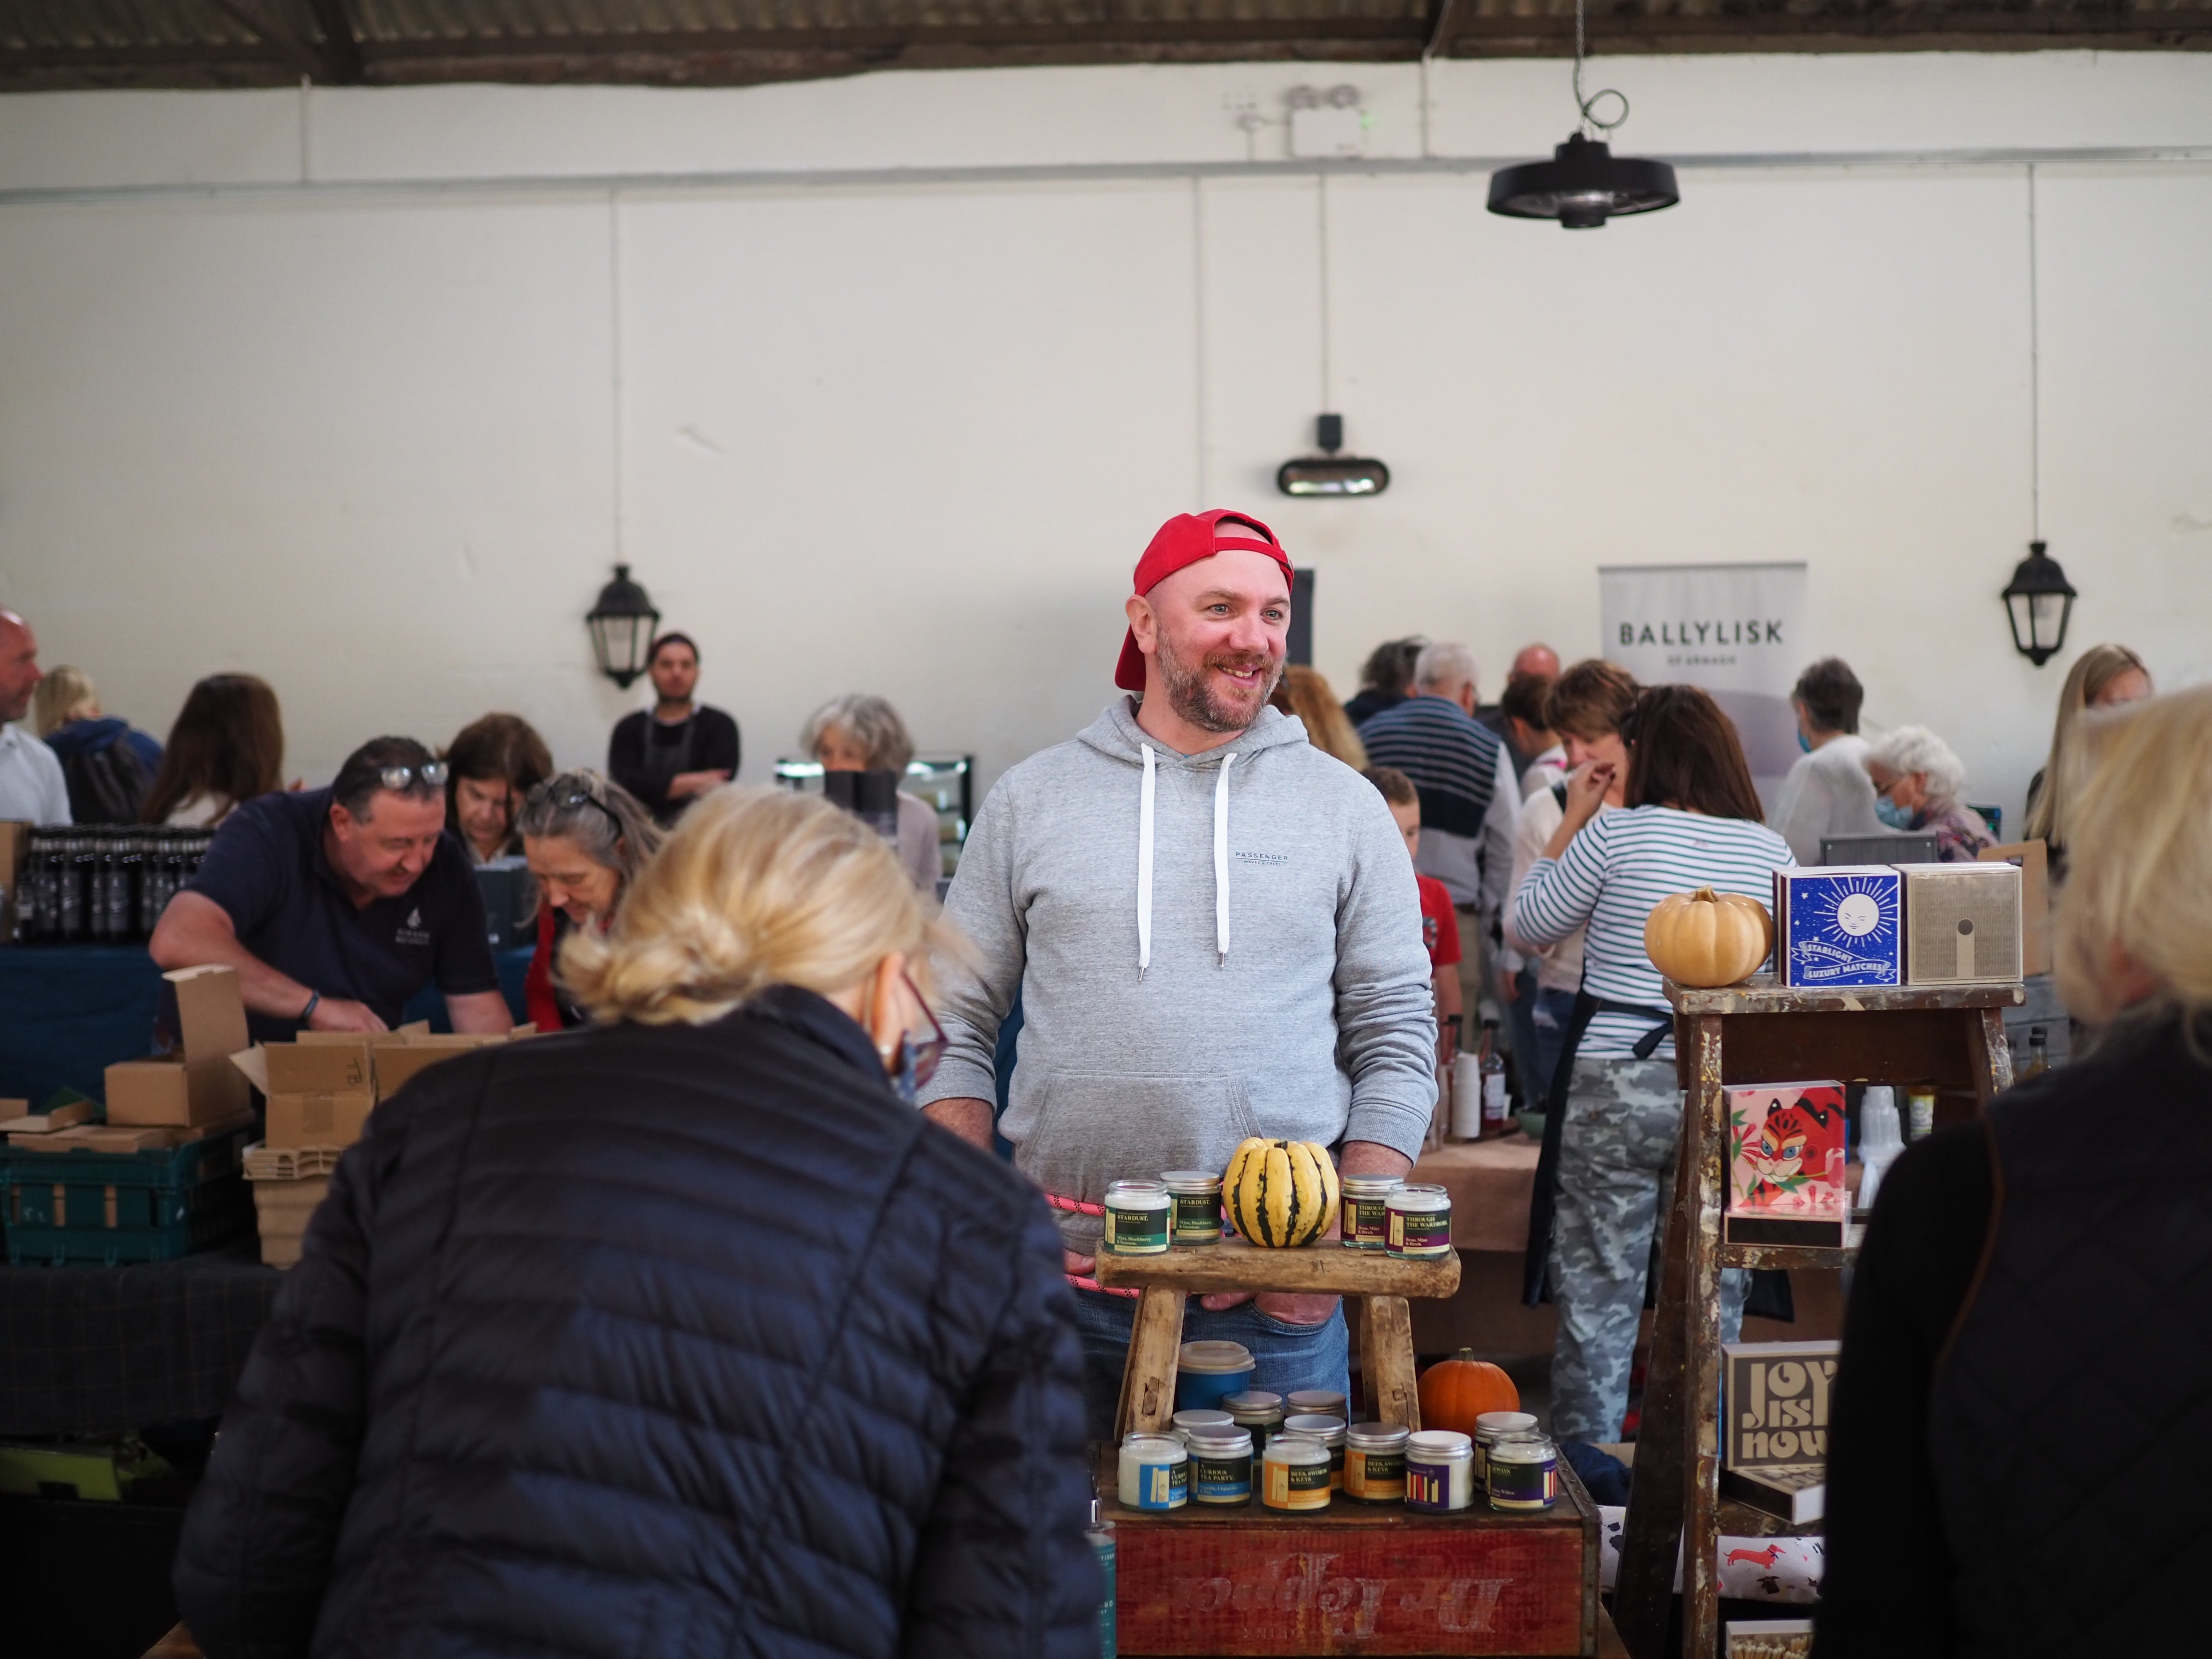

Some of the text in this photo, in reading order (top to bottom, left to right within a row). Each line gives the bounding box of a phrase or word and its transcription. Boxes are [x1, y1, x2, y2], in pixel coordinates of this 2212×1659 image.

[1619, 620, 1783, 645] BALLYLISK
[1236, 852, 1288, 860] PASSENGER
[1807, 944, 1853, 962] STARLIGHT
[1809, 962, 1883, 978] LUXURY MATCHES
[1742, 1360, 1838, 1429] JOY
[1399, 1577, 1514, 1634] Dr
